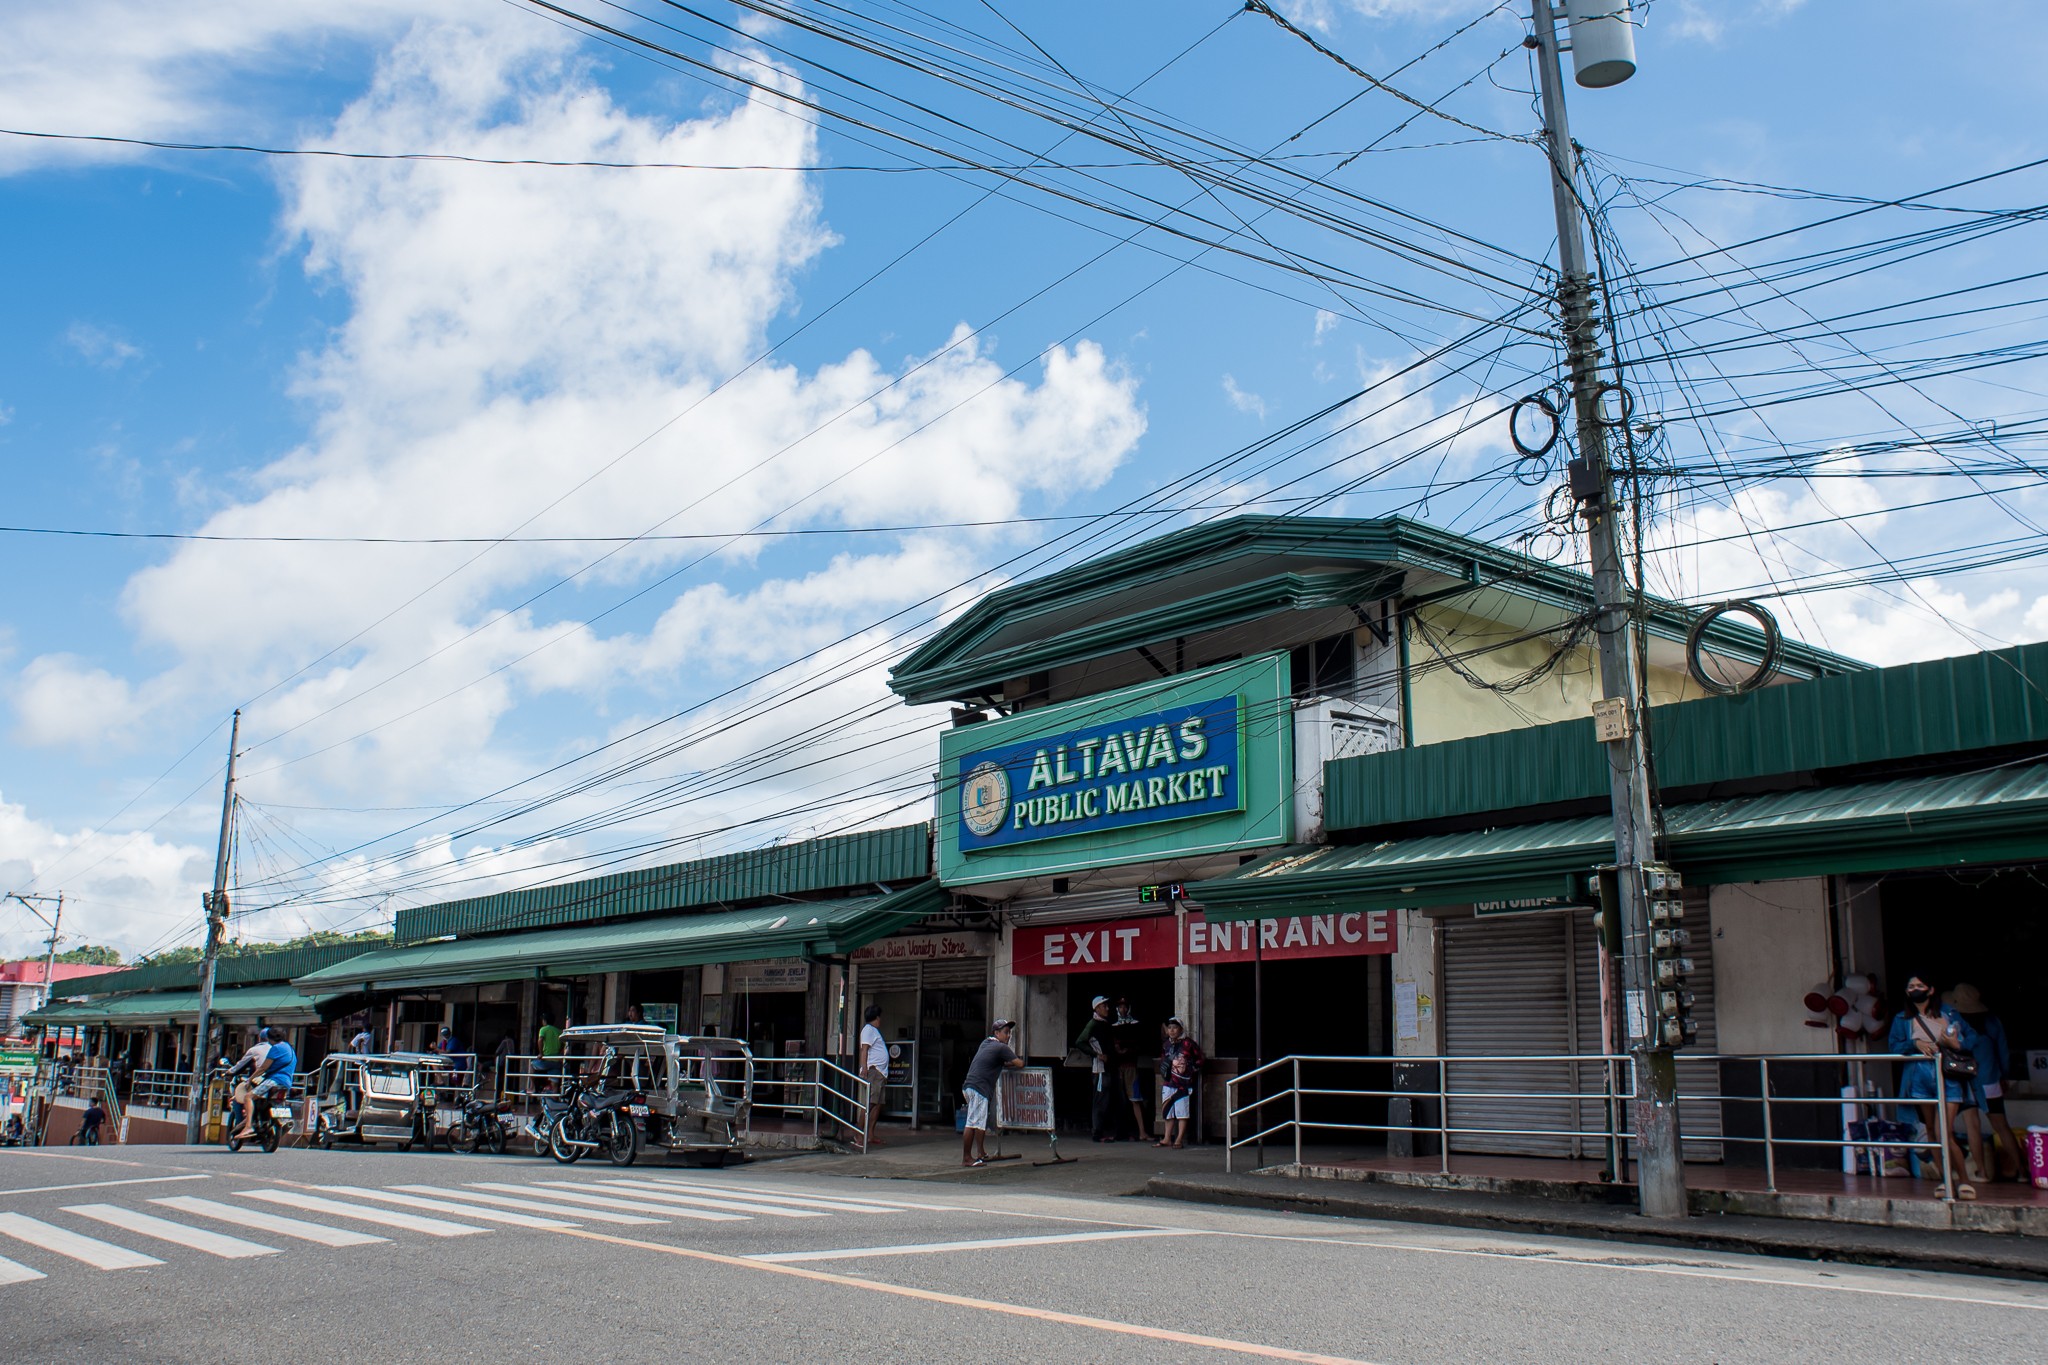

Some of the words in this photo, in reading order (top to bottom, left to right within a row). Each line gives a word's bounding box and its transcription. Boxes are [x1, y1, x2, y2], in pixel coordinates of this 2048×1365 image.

[1027, 715, 1208, 791] ALTAVAS
[1013, 786, 1101, 830] PUBLIC
[1105, 764, 1229, 816] MARKET
[886, 941, 906, 958] Bien
[907, 938, 937, 958] Variety
[1043, 928, 1140, 966] EXIT
[1189, 909, 1389, 953] ENTRANCE
[1001, 1072, 1016, 1122] NO
[1015, 1073, 1046, 1087] LOADING
[1017, 1109, 1048, 1123] PARKING
